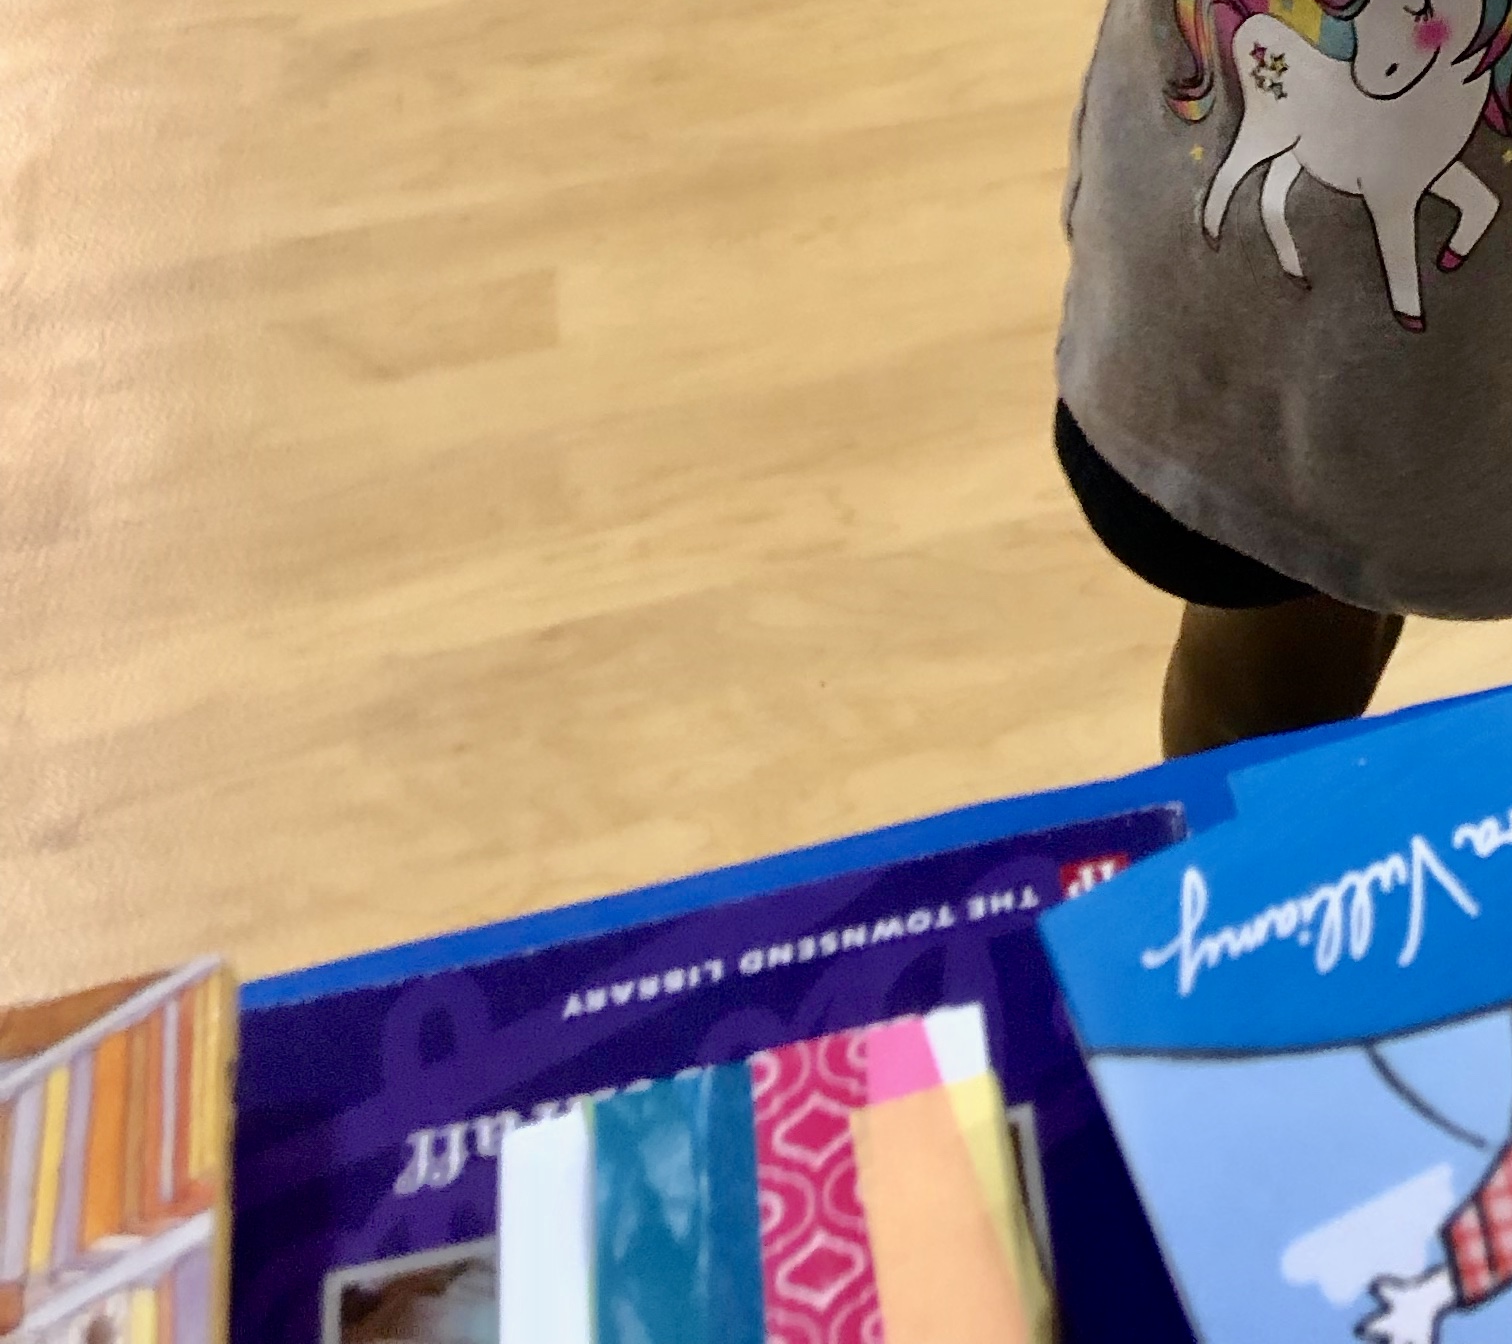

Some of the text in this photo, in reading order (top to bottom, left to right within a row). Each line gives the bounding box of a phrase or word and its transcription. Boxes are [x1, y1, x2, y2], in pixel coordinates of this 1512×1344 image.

[562, 885, 1041, 1021] THE TOWNSEND LIBRARY
[1141, 834, 1480, 998] Vulliamy
